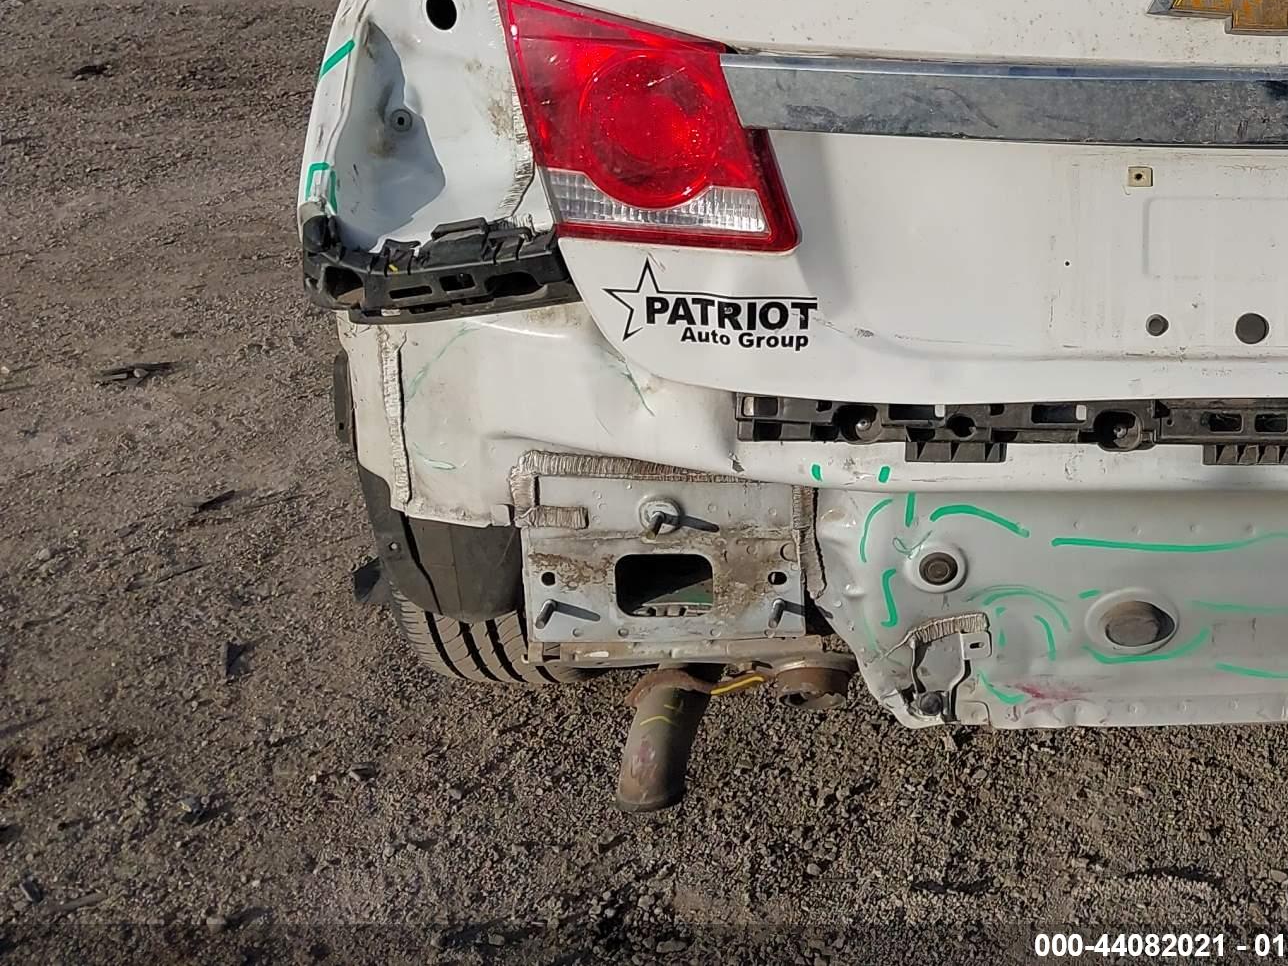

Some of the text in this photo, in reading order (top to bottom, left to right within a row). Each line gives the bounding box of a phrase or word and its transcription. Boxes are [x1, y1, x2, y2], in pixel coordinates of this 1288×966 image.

[645, 296, 818, 331] PATRIOT
[680, 326, 809, 352] Auto Group
